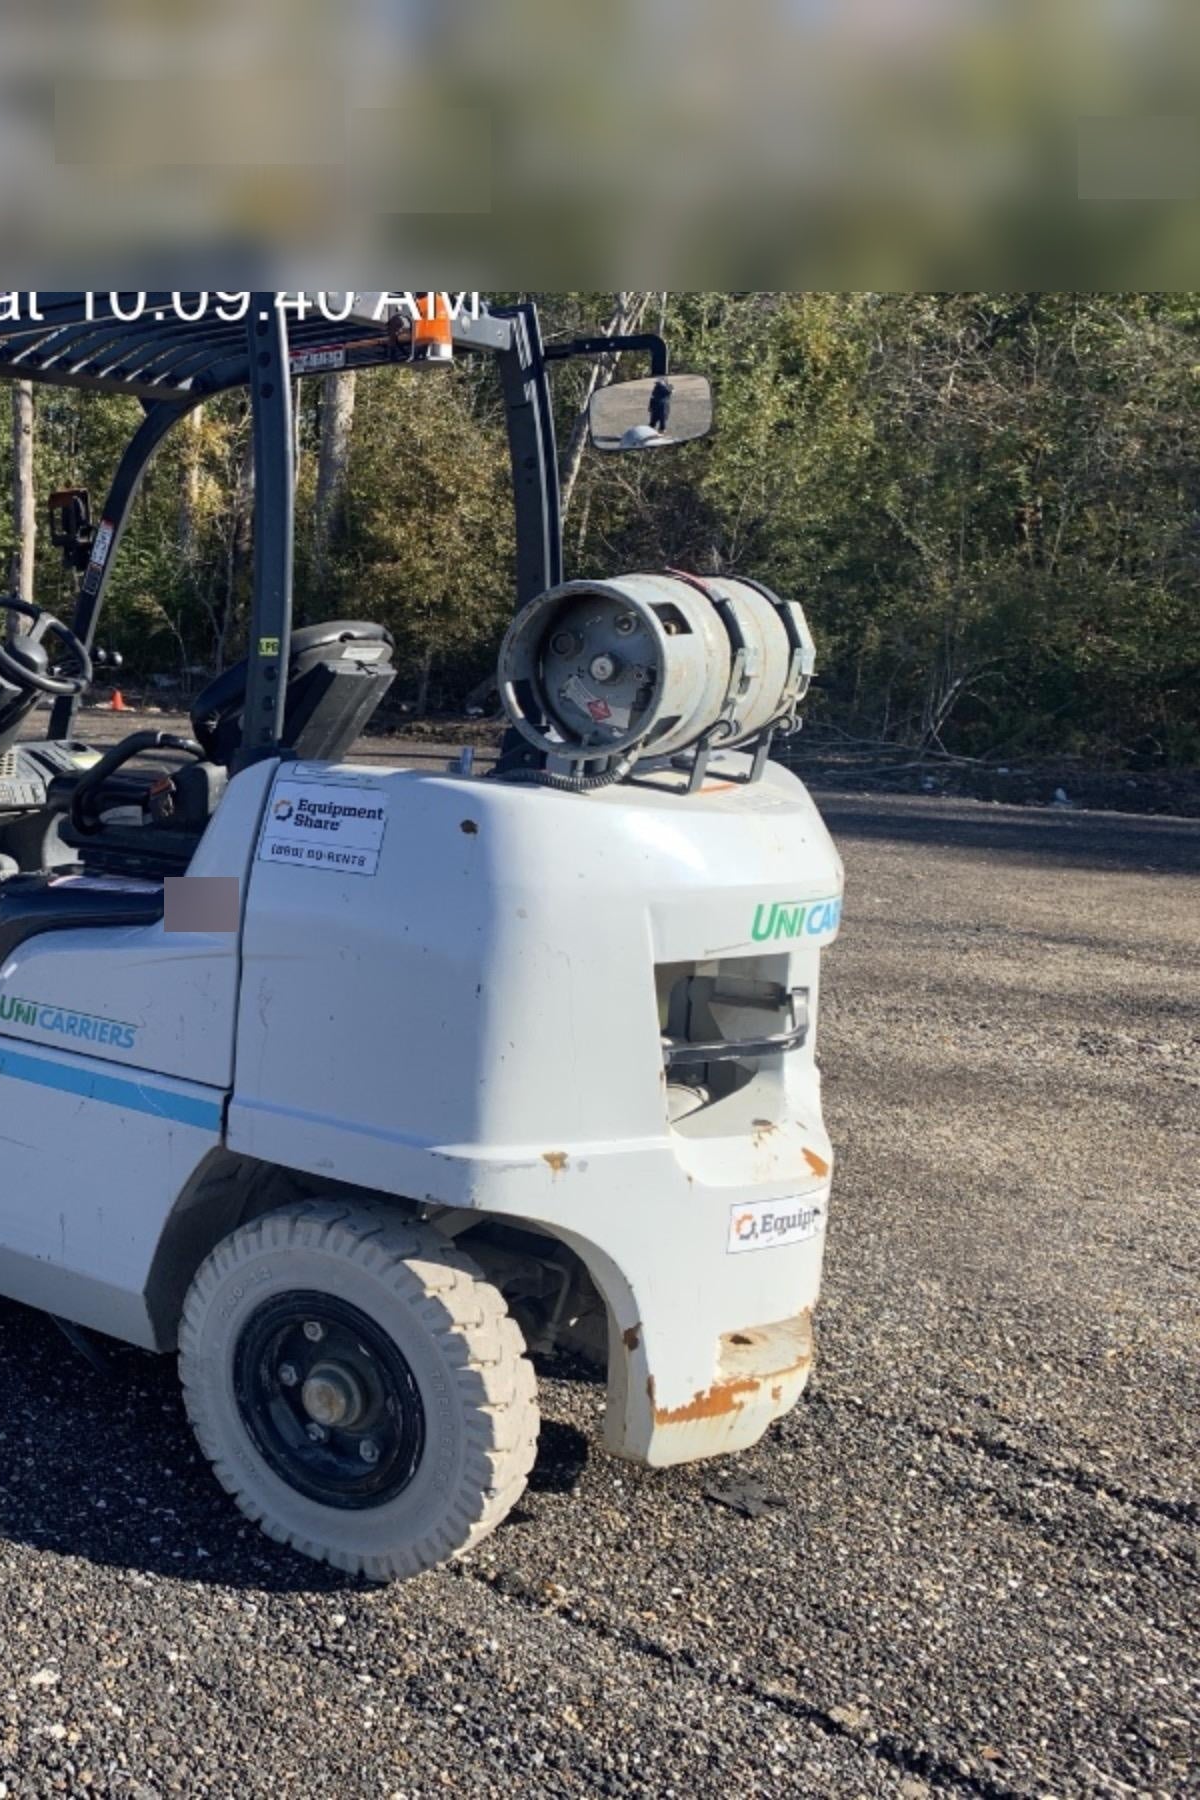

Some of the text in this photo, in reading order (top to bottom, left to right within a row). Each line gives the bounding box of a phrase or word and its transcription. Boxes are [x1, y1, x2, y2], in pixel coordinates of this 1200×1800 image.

[296, 798, 385, 821] Equipment
[293, 813, 341, 831] Share
[0, 994, 137, 1049] UNICARRIERS
